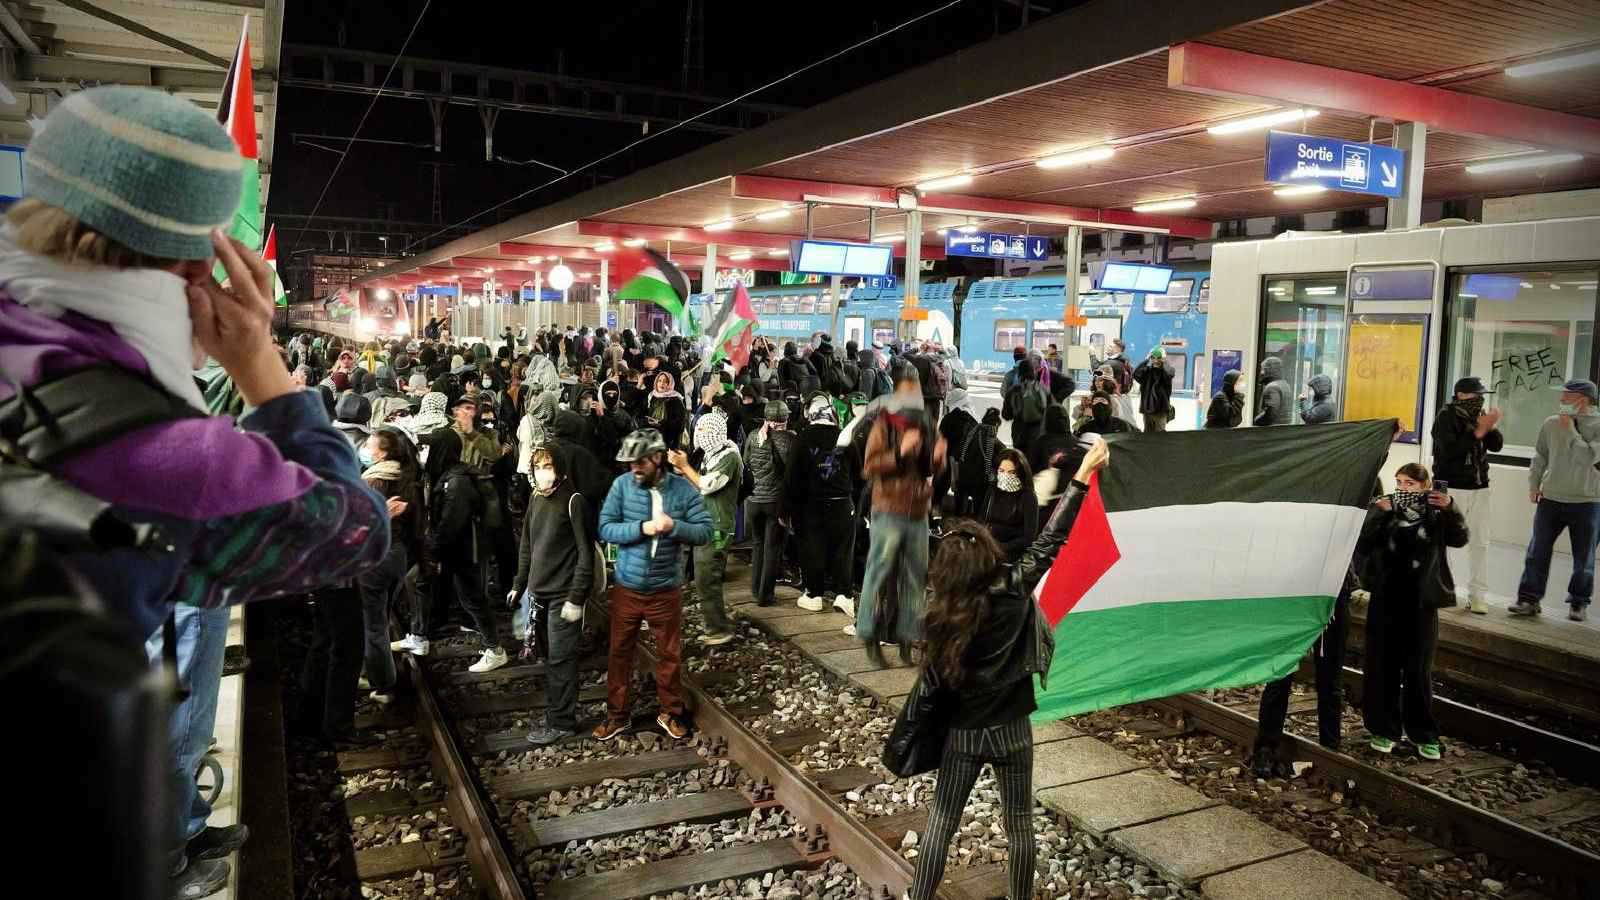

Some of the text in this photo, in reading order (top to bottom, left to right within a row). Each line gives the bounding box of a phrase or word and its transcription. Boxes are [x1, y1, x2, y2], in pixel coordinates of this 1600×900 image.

[1297, 143, 1334, 162] Sortie
[970, 244, 985, 253] Exit
[872, 278, 893, 288] E 7
[1491, 346, 1556, 373] FREE
